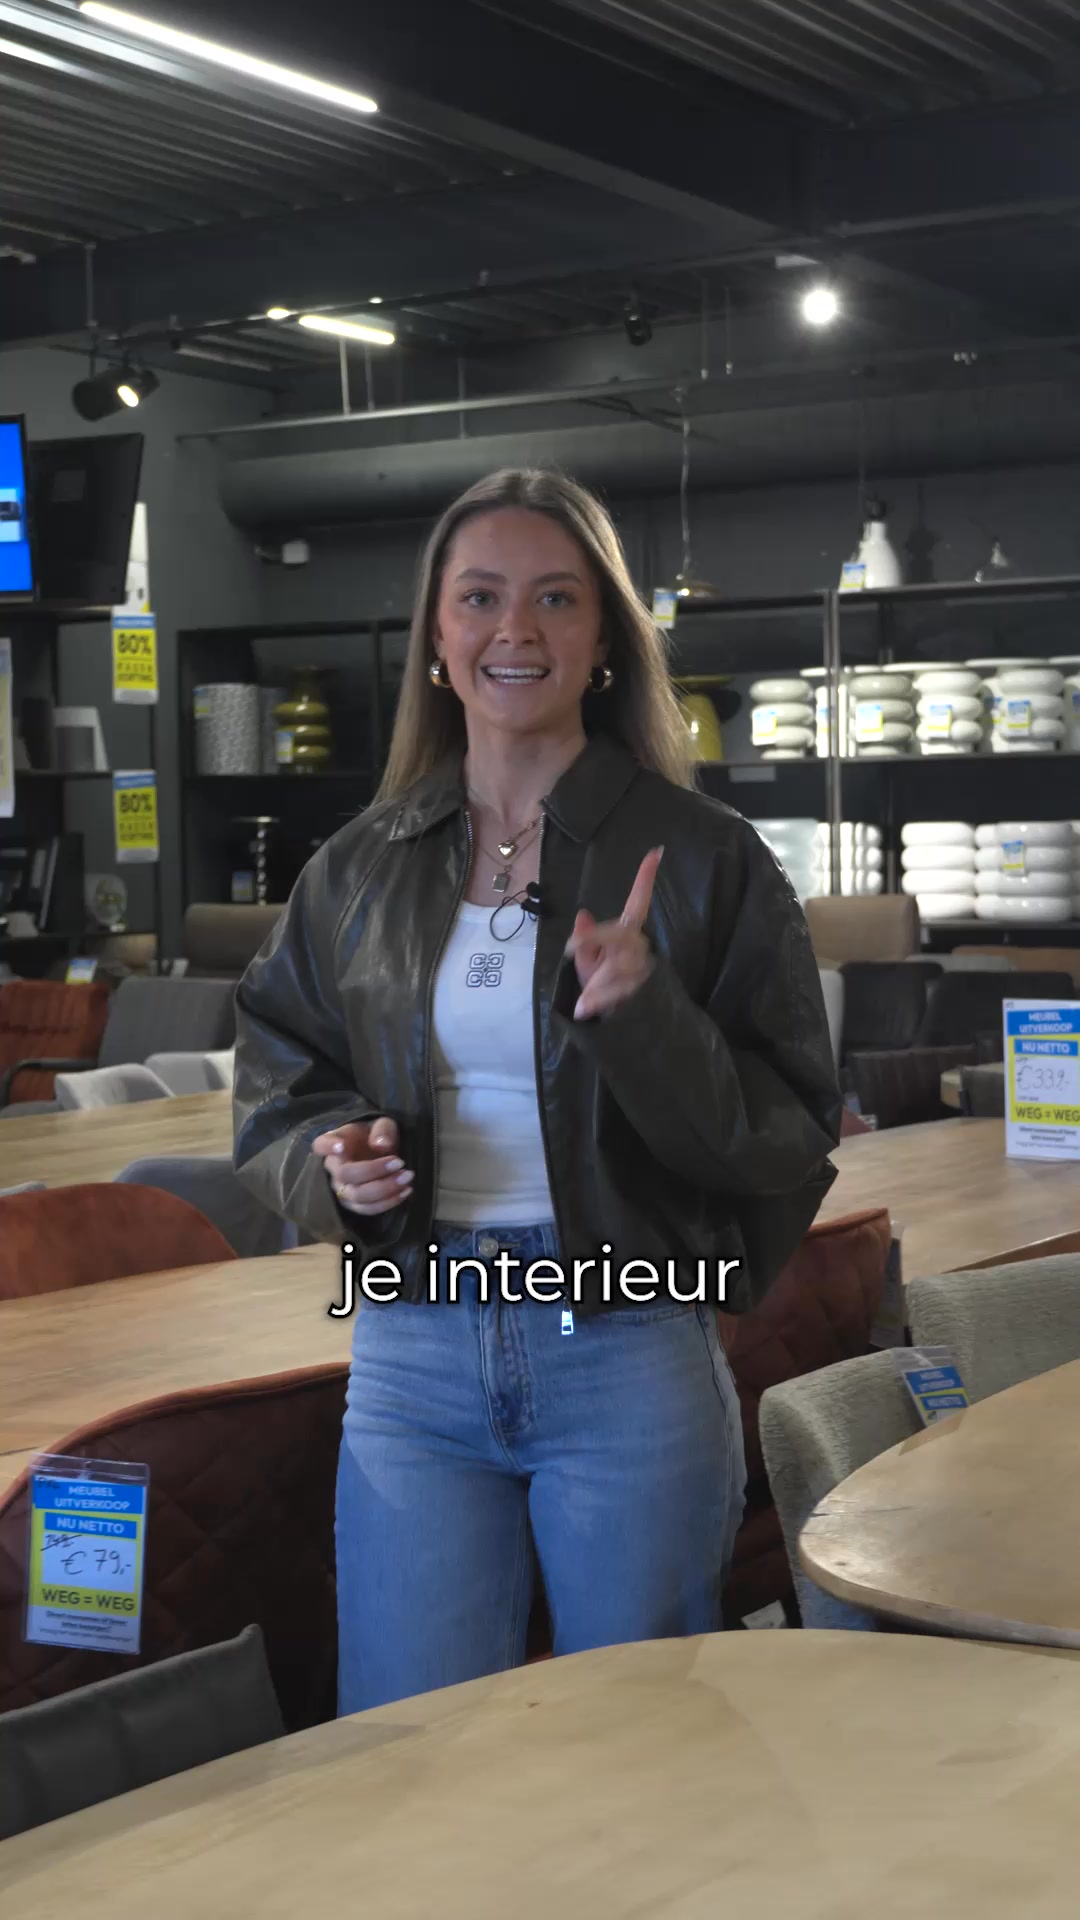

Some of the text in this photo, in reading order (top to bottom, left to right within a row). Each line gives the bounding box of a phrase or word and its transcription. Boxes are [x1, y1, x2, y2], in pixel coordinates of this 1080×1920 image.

[118, 633, 152, 654] 80%
[119, 793, 153, 814] 80%
[1029, 1012, 1062, 1021] MEUBEL
[1019, 1023, 1073, 1033] UITVERKOOP
[1022, 1042, 1071, 1053] NU NETTO
[1015, 1107, 1042, 1120] WEG
[1053, 1109, 1080, 1122] WEG
[68, 1486, 116, 1497] MEUBEL
[54, 1498, 130, 1511] UITVERKOOP
[56, 1517, 125, 1534] NU NETTO
[42, 1588, 80, 1605] WEG
[96, 1594, 135, 1611] WEG
